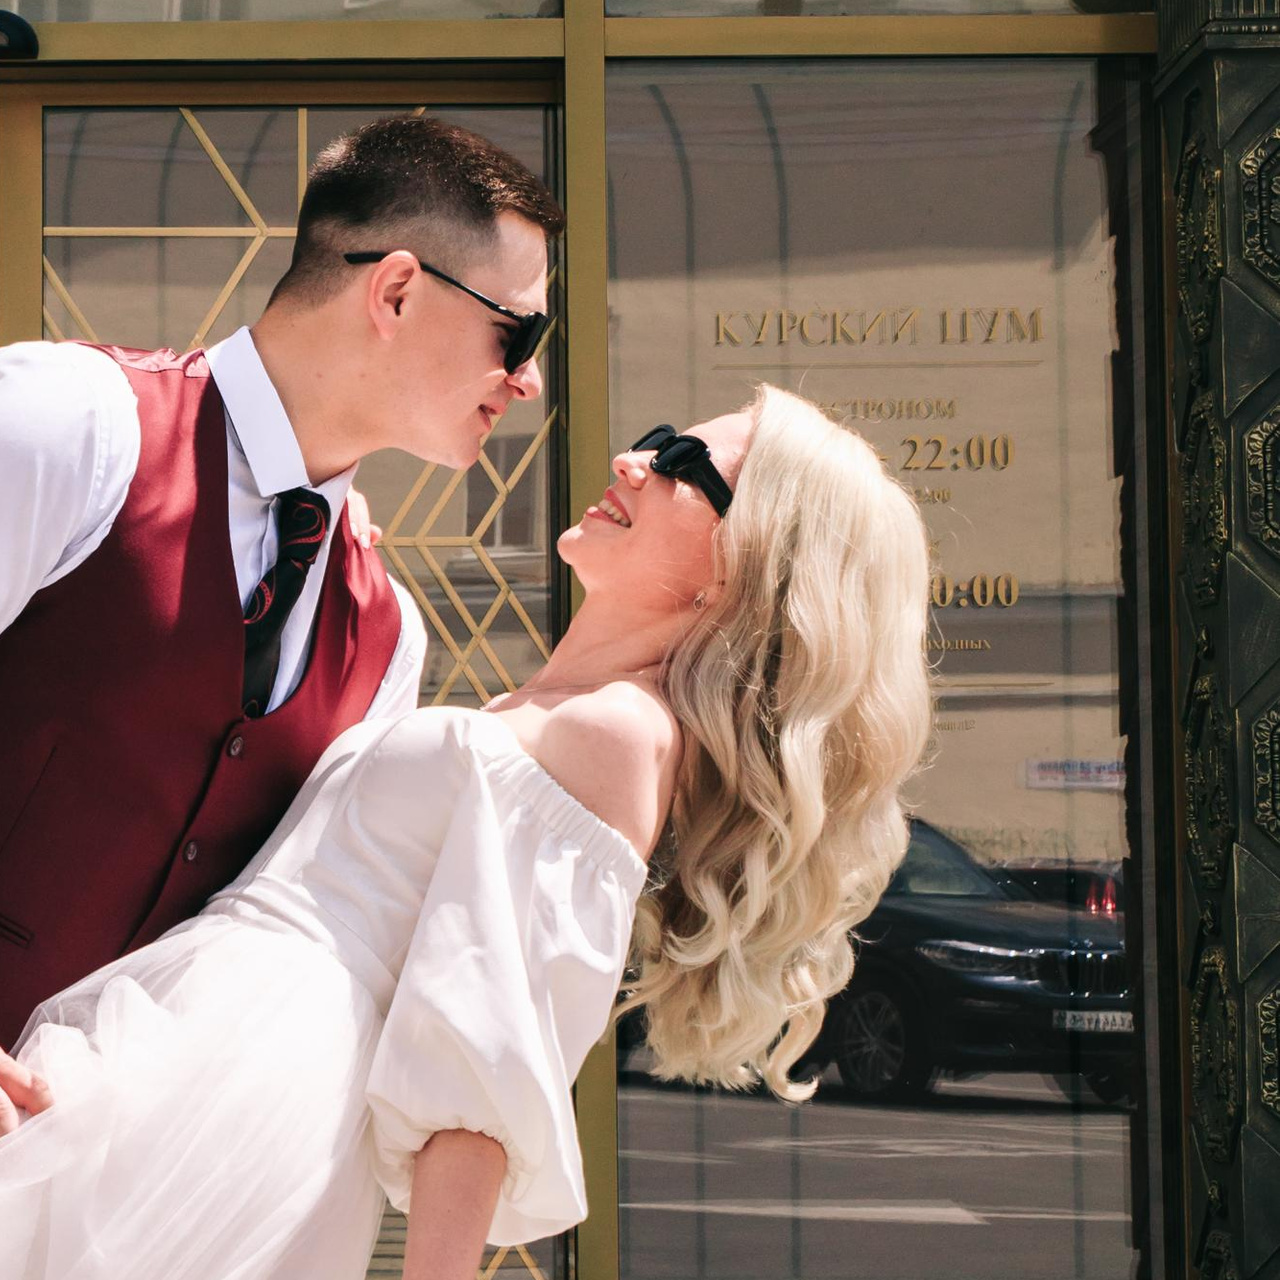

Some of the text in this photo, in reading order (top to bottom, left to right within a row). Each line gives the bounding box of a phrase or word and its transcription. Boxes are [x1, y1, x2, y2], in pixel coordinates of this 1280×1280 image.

[714, 306, 1044, 347] КУРСКИЙ ЦУМ
[823, 397, 960, 420] СТРОНОМ
[900, 433, 1015, 471] 22:00
[931, 572, 1020, 608] 0:00
[927, 638, 992, 651] ХОДНЫХ
